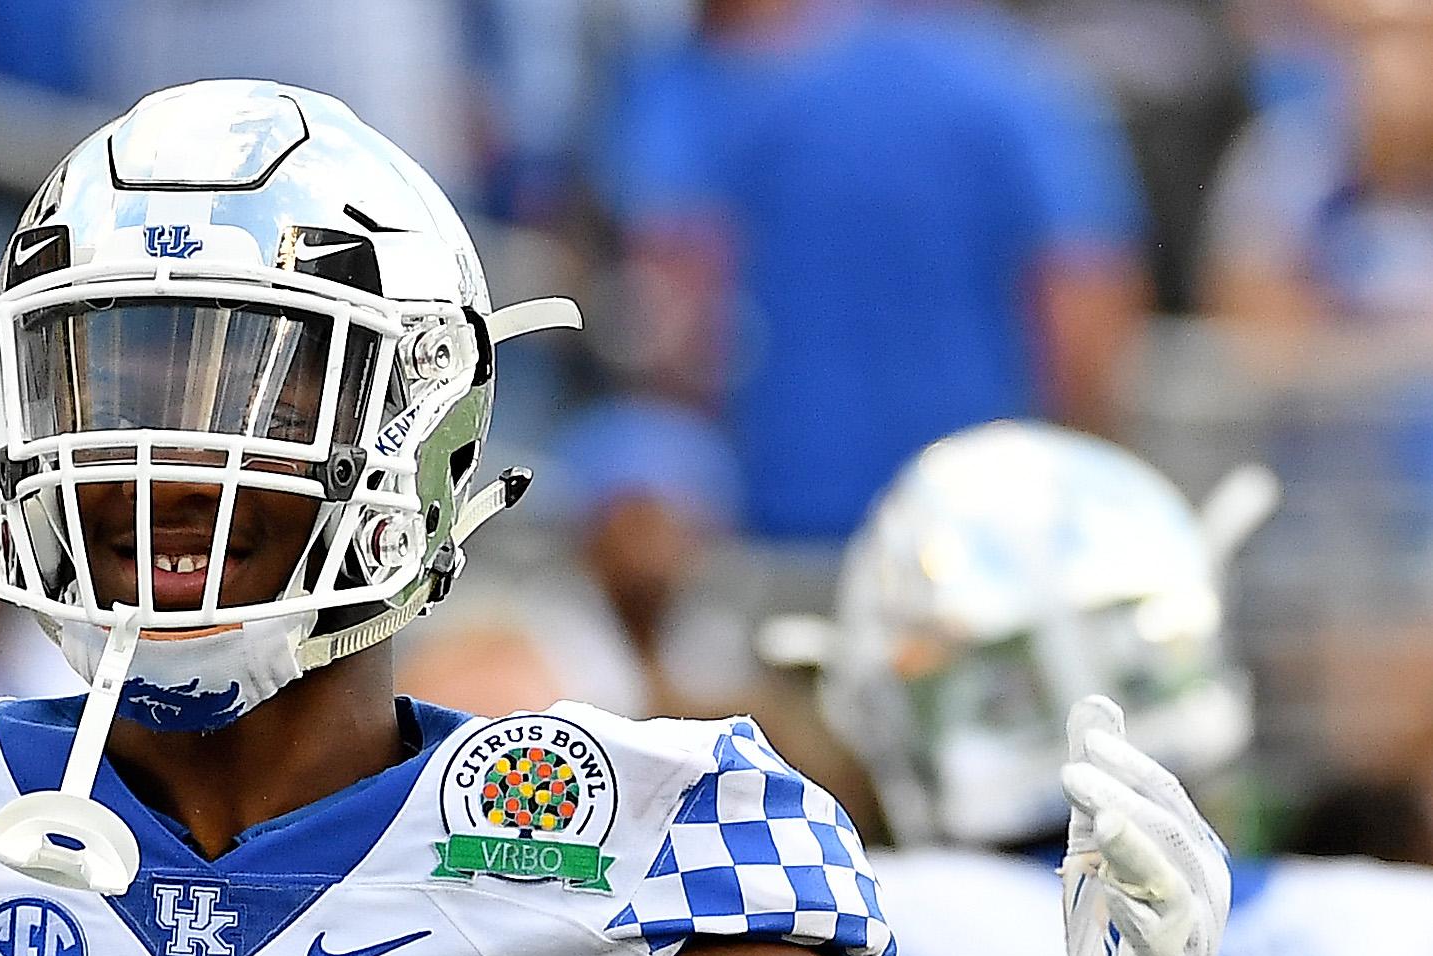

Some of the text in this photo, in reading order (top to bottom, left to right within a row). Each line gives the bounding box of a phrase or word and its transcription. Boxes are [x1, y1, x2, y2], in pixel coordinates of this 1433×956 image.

[455, 725, 606, 799] CITRUS BOWL
[481, 841, 563, 872] VRBO
